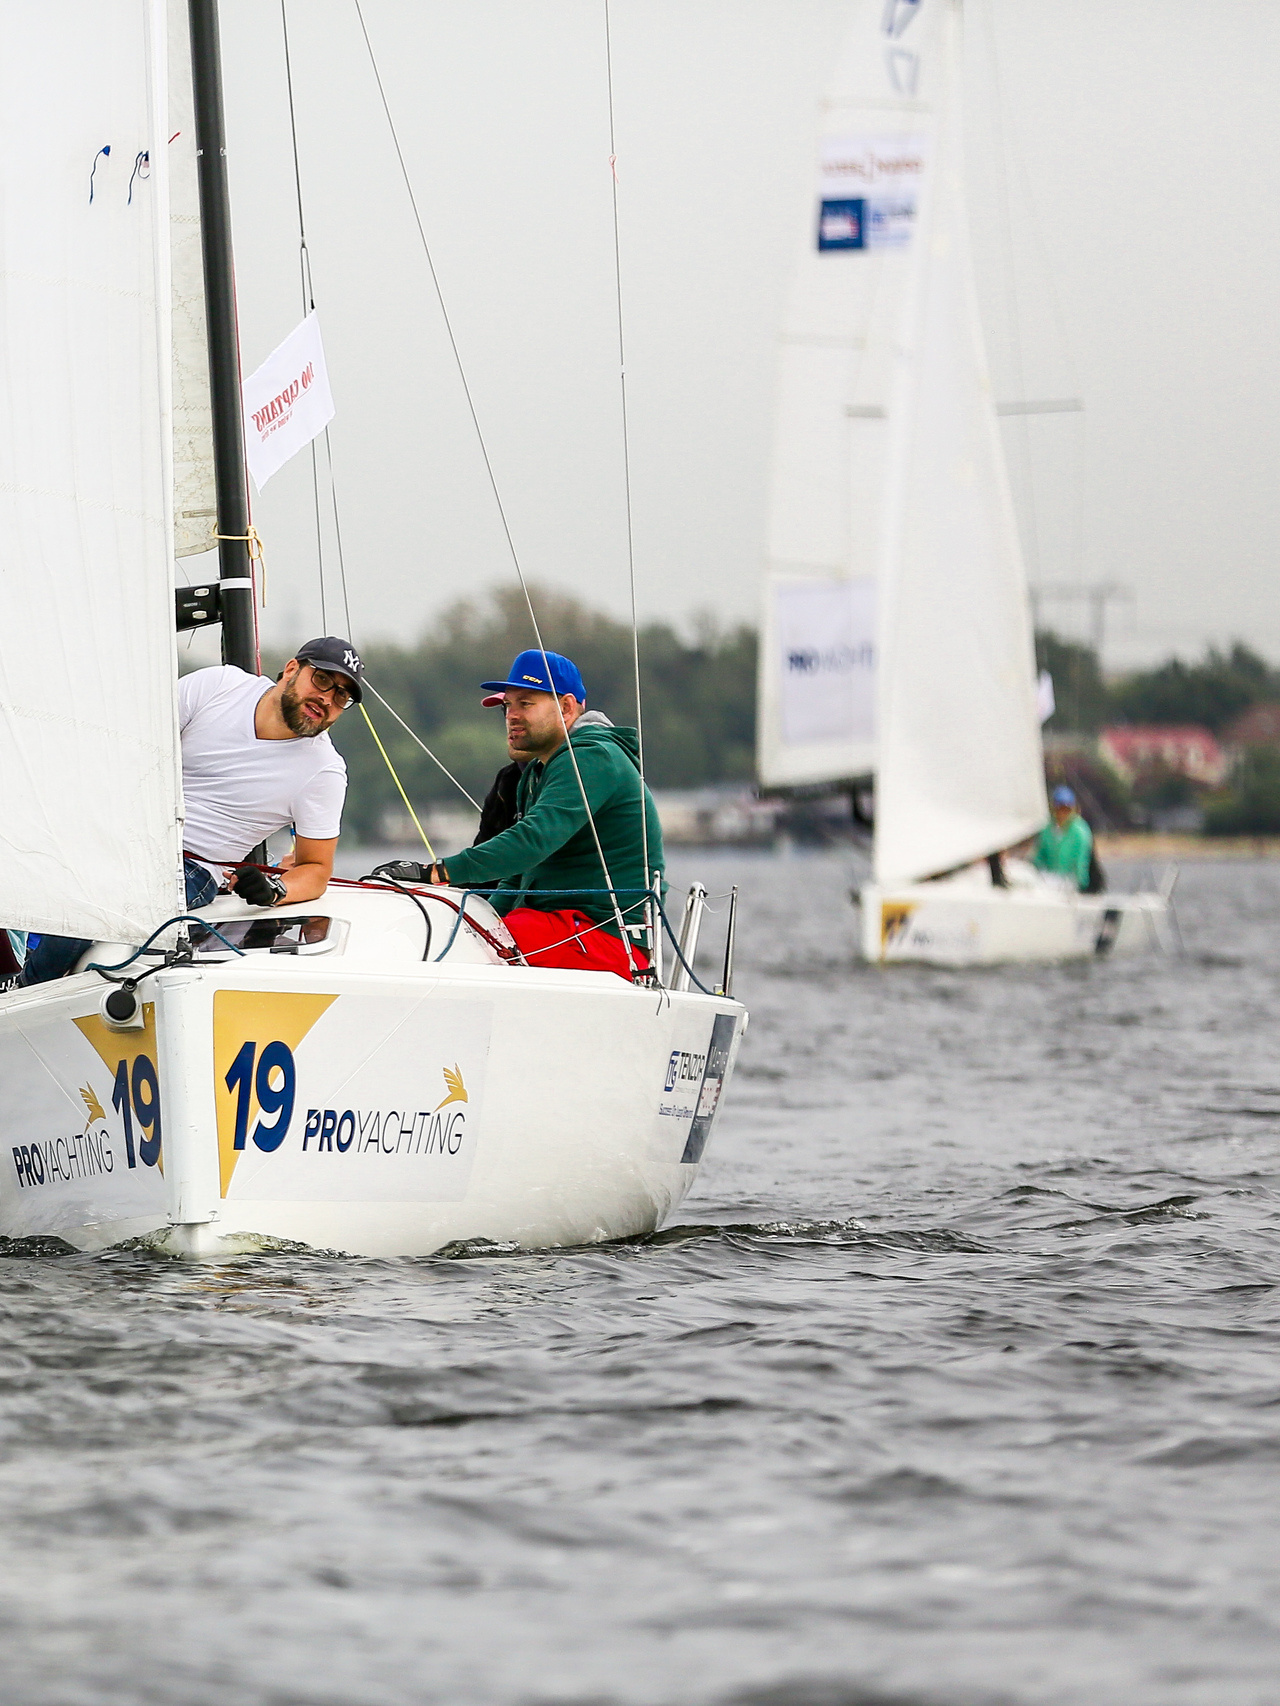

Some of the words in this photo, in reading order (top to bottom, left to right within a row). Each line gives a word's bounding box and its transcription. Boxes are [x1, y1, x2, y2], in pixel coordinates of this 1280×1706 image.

[343, 649, 360, 673] NY
[112, 1054, 162, 1169] 19
[225, 1041, 296, 1153] 19
[11, 1130, 114, 1188] PROYACHTING
[303, 1107, 466, 1156] PROYACHTING
